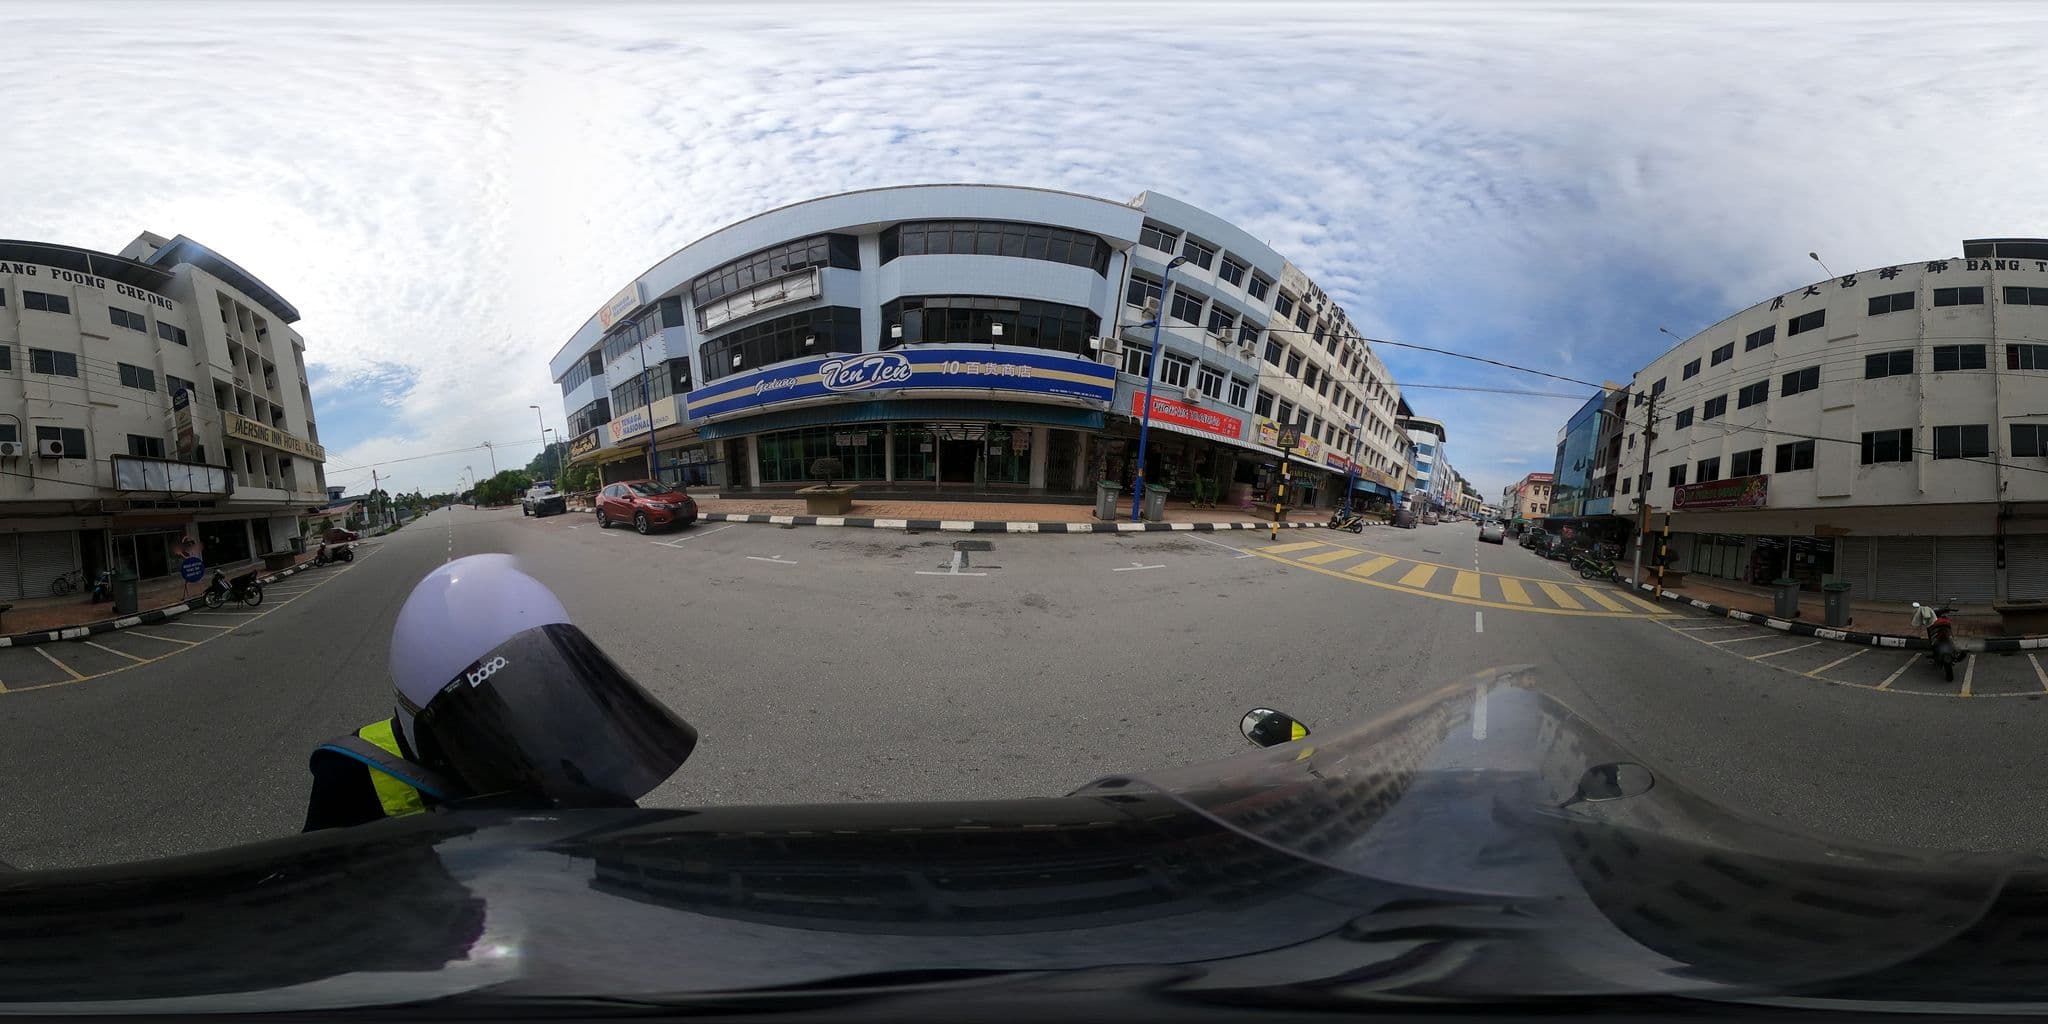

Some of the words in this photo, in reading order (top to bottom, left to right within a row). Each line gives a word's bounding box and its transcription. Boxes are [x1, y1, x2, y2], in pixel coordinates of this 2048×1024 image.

[51, 268, 106, 290] FOONG
[117, 284, 174, 311] CHEONG
[1307, 278, 1328, 306] YUNG
[820, 362, 866, 387] Ten
[865, 357, 911, 383] Ten
[941, 360, 960, 375] 10
[754, 377, 798, 396] Gedung
[621, 413, 642, 427] TENAGA
[623, 420, 650, 435] NASIONAL
[235, 419, 270, 442] MERSING
[272, 431, 282, 446] INN
[284, 435, 302, 452] HOTEL
